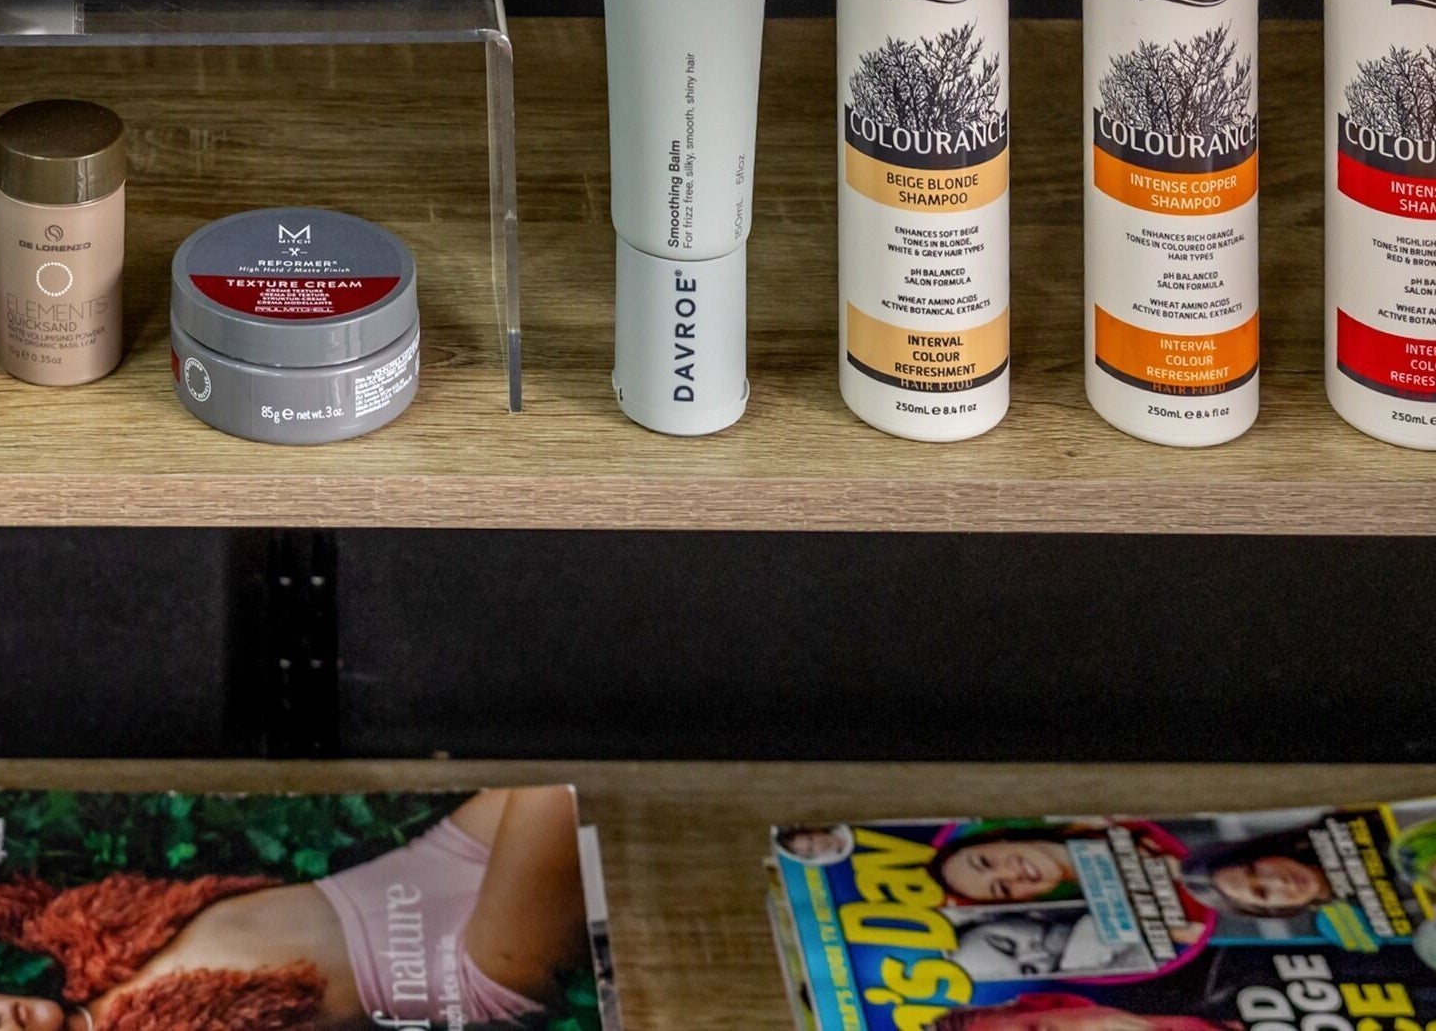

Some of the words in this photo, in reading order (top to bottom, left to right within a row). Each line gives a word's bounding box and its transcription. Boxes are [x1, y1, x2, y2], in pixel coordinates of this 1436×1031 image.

[684, 53, 695, 74] hair
[684, 76, 697, 104] shiny
[684, 107, 696, 150] smooth,
[849, 110, 1007, 155] COLOURANCE
[1099, 113, 1257, 159] COLOURANCE
[668, 139, 680, 173] Balm
[887, 172, 924, 190] BEIGE
[928, 173, 979, 190] BLONDE
[1130, 172, 1187, 194] INTENSE
[1190, 175, 1237, 194] COPPER
[899, 190, 968, 206] SHAMPOO
[1151, 194, 1221, 210] SHAMPOO
[668, 176, 683, 248] Smoothing
[683, 206, 694, 229] frizz
[894, 226, 938, 238] ENHANCES
[939, 228, 958, 238] SOFT
[959, 226, 979, 237] BEIGE
[18, 240, 33, 250] DE
[36, 242, 91, 252] LORENZO
[683, 232, 693, 249] For
[902, 237, 930, 247] TONES
[930, 239, 938, 247] IN
[887, 243, 913, 256] WHITE
[921, 249, 943, 258] GREY
[944, 248, 963, 257] HAIR
[963, 244, 985, 256] TYPES
[226, 279, 299, 288] TEXTURE
[305, 280, 363, 288] CREAM
[1404, 285, 1432, 296] SALON
[6, 293, 110, 322] ELEMENTS
[1377, 308, 1407, 323] ACTIVE
[907, 335, 964, 347] INTERVAL
[1160, 338, 1217, 350] INTERVAL
[913, 351, 960, 362] COLOUR
[1165, 354, 1213, 366] COLOUR
[894, 362, 976, 377] REFRESHMENT
[1146, 366, 1229, 381] REFRESHMENT
[261, 406, 280, 423] 85g
[296, 408, 311, 420] net
[325, 406, 333, 418] 3
[896, 401, 930, 415] 250mL
[943, 405, 958, 415] 8.4
[959, 403, 966, 413] fl
[967, 403, 977, 412] oz
[1147, 405, 1183, 419] 250mL
[1391, 410, 1428, 426] 250mL
[839, 827, 959, 951] Day
[386, 883, 429, 1002] nature
